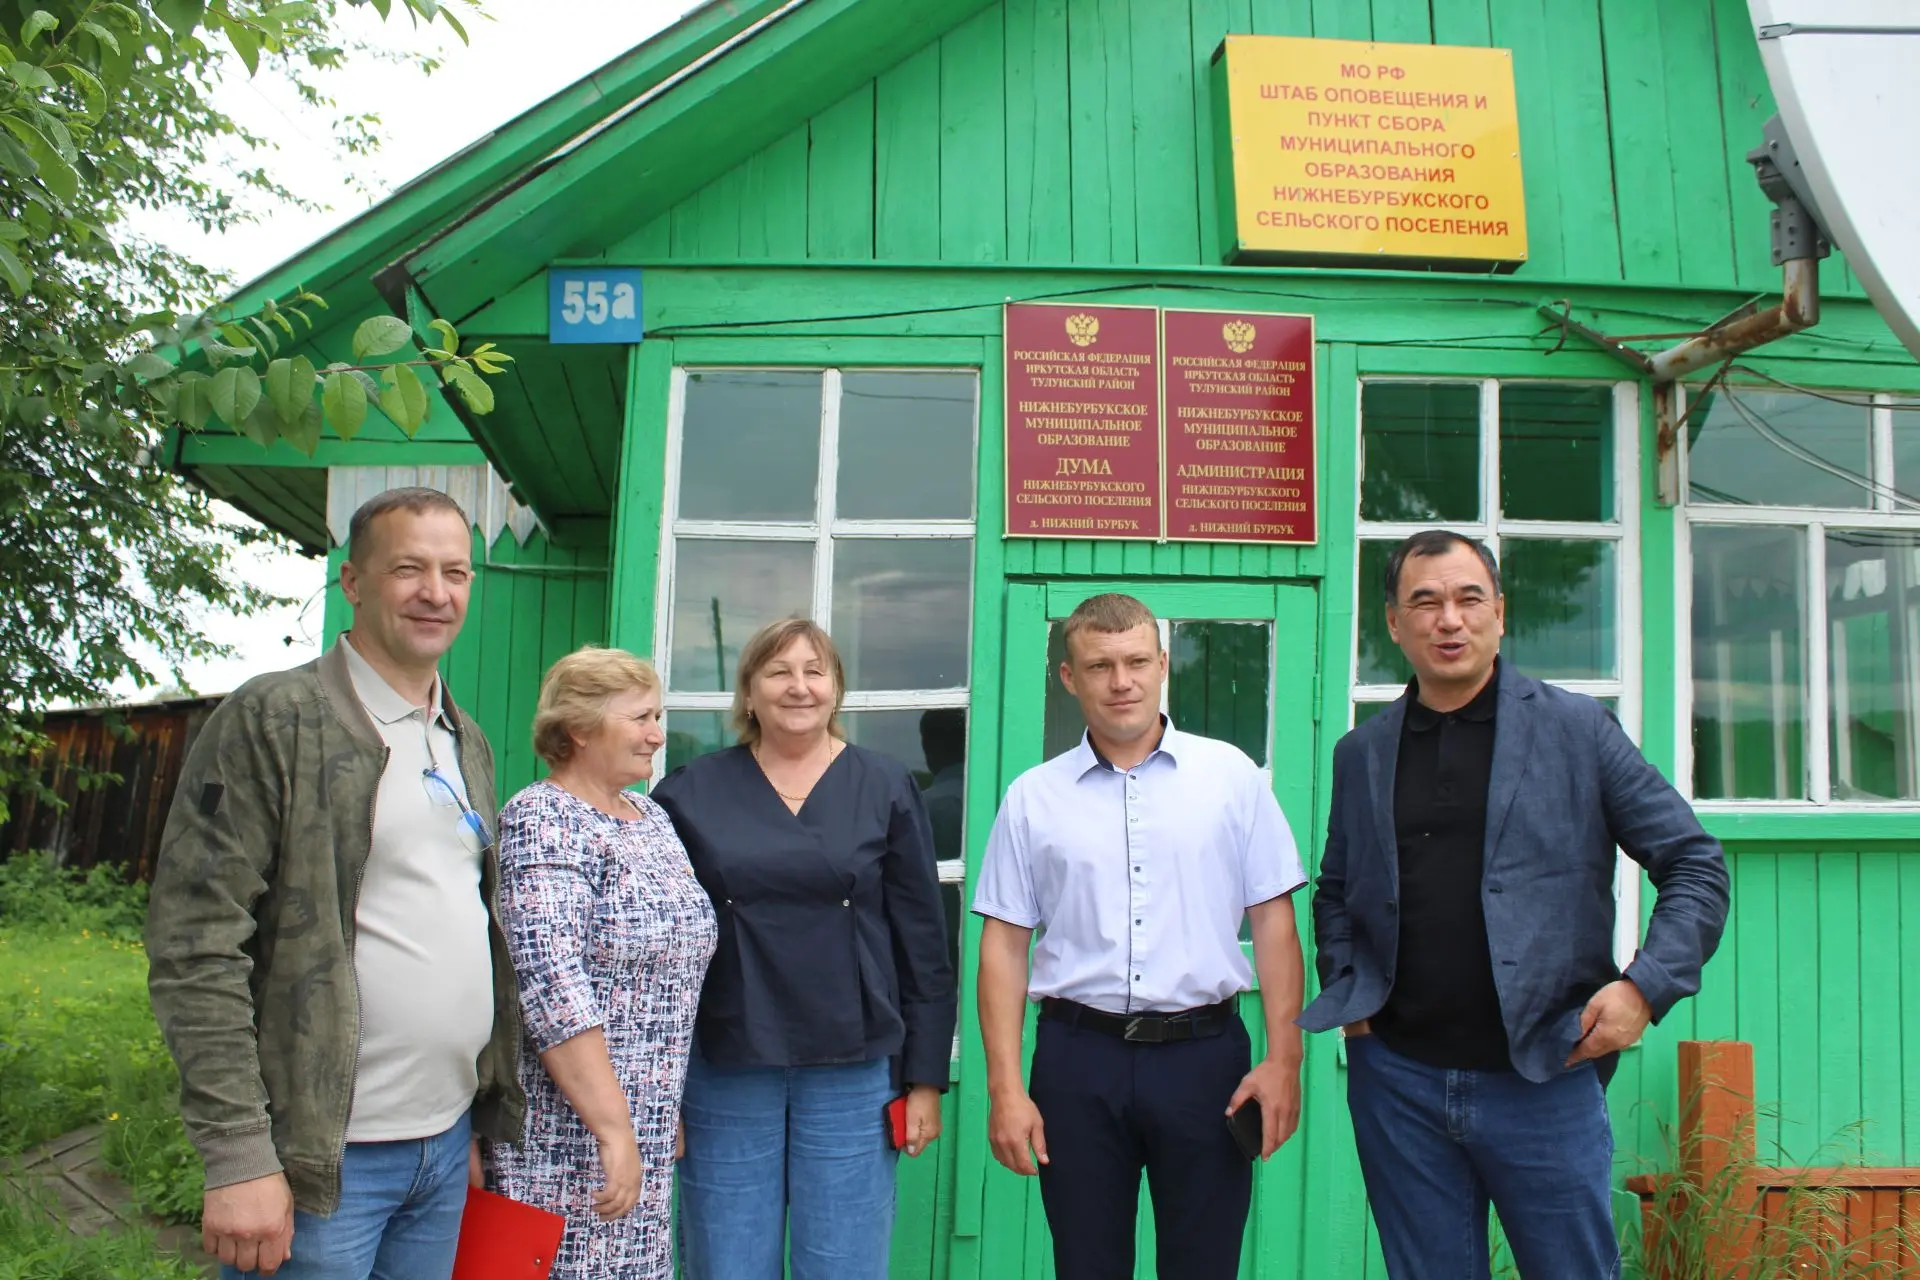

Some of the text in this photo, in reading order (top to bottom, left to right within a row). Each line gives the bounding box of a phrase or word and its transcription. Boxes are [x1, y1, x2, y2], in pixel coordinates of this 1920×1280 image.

[1341, 63, 1405, 80] МО РФ
[1260, 84, 1487, 109] ШТАБ ОПОВЕЩЕНИЯ И
[1308, 112, 1445, 132] ПУНКТ СБОРА
[1280, 135, 1475, 159] МУНИЦИПАЛЬНОГО
[1304, 162, 1455, 183] ОБРАЗОВАНИЯ
[1273, 185, 1489, 210] НИЖНЕБУРБУКСКОГО
[1256, 211, 1509, 236] СЕЛЬСКОГО ПОСЕЛЕНИЯ
[562, 280, 635, 325] 55а
[1014, 350, 1151, 364] РОССИЙСКАЯ ФЕДЕРАЦИЯ
[1172, 356, 1306, 371] РОССИЙСКАЯ ФЕДЕРАЦИЯ
[1026, 364, 1140, 377] ИРКУТСКАЯ ОБЛАСТЬ
[1184, 370, 1295, 383] ИРКУТСКАЯ ОБЛАСТЬ
[1031, 377, 1135, 390] ТУЛУНСКИЙ РАЙОН
[1189, 383, 1290, 396] ТУЛУНСКИЙ РАЙОН
[1019, 401, 1148, 415] НИЖНЕБУРБУКСКОЕ
[1178, 407, 1303, 422] НИЖНЕБУРБУКСКОЕ
[1025, 418, 1142, 431] МУНИЦИПАЛЬНОЕ
[1184, 423, 1298, 437] МУНИЦИПАЛЬНОЕ
[1038, 433, 1130, 447] ОБРАЗОВАНИЕ
[1196, 439, 1286, 453] ОБРАЗОВАНИЕ
[1056, 458, 1112, 476] ДУМА
[1177, 464, 1305, 481] АДМИНИСТРАЦИЯ
[1023, 480, 1145, 492] НИЖНЕБУРБУКСКОГО
[1182, 484, 1300, 497] НИЖНЕБУРБУКСКОГО
[1016, 493, 1152, 507] СЕЛЬСКОГО ПОСЕЛЕНИЯ
[1176, 498, 1306, 512] СЕЛЬСКОГО ПОСЕЛЕНИЯ
[1042, 517, 1094, 529] НИЖНИЙ
[1097, 519, 1139, 530] БУРБУК
[1200, 522, 1250, 533] НИЖНИЙ
[1254, 524, 1294, 535] БУРБУК
